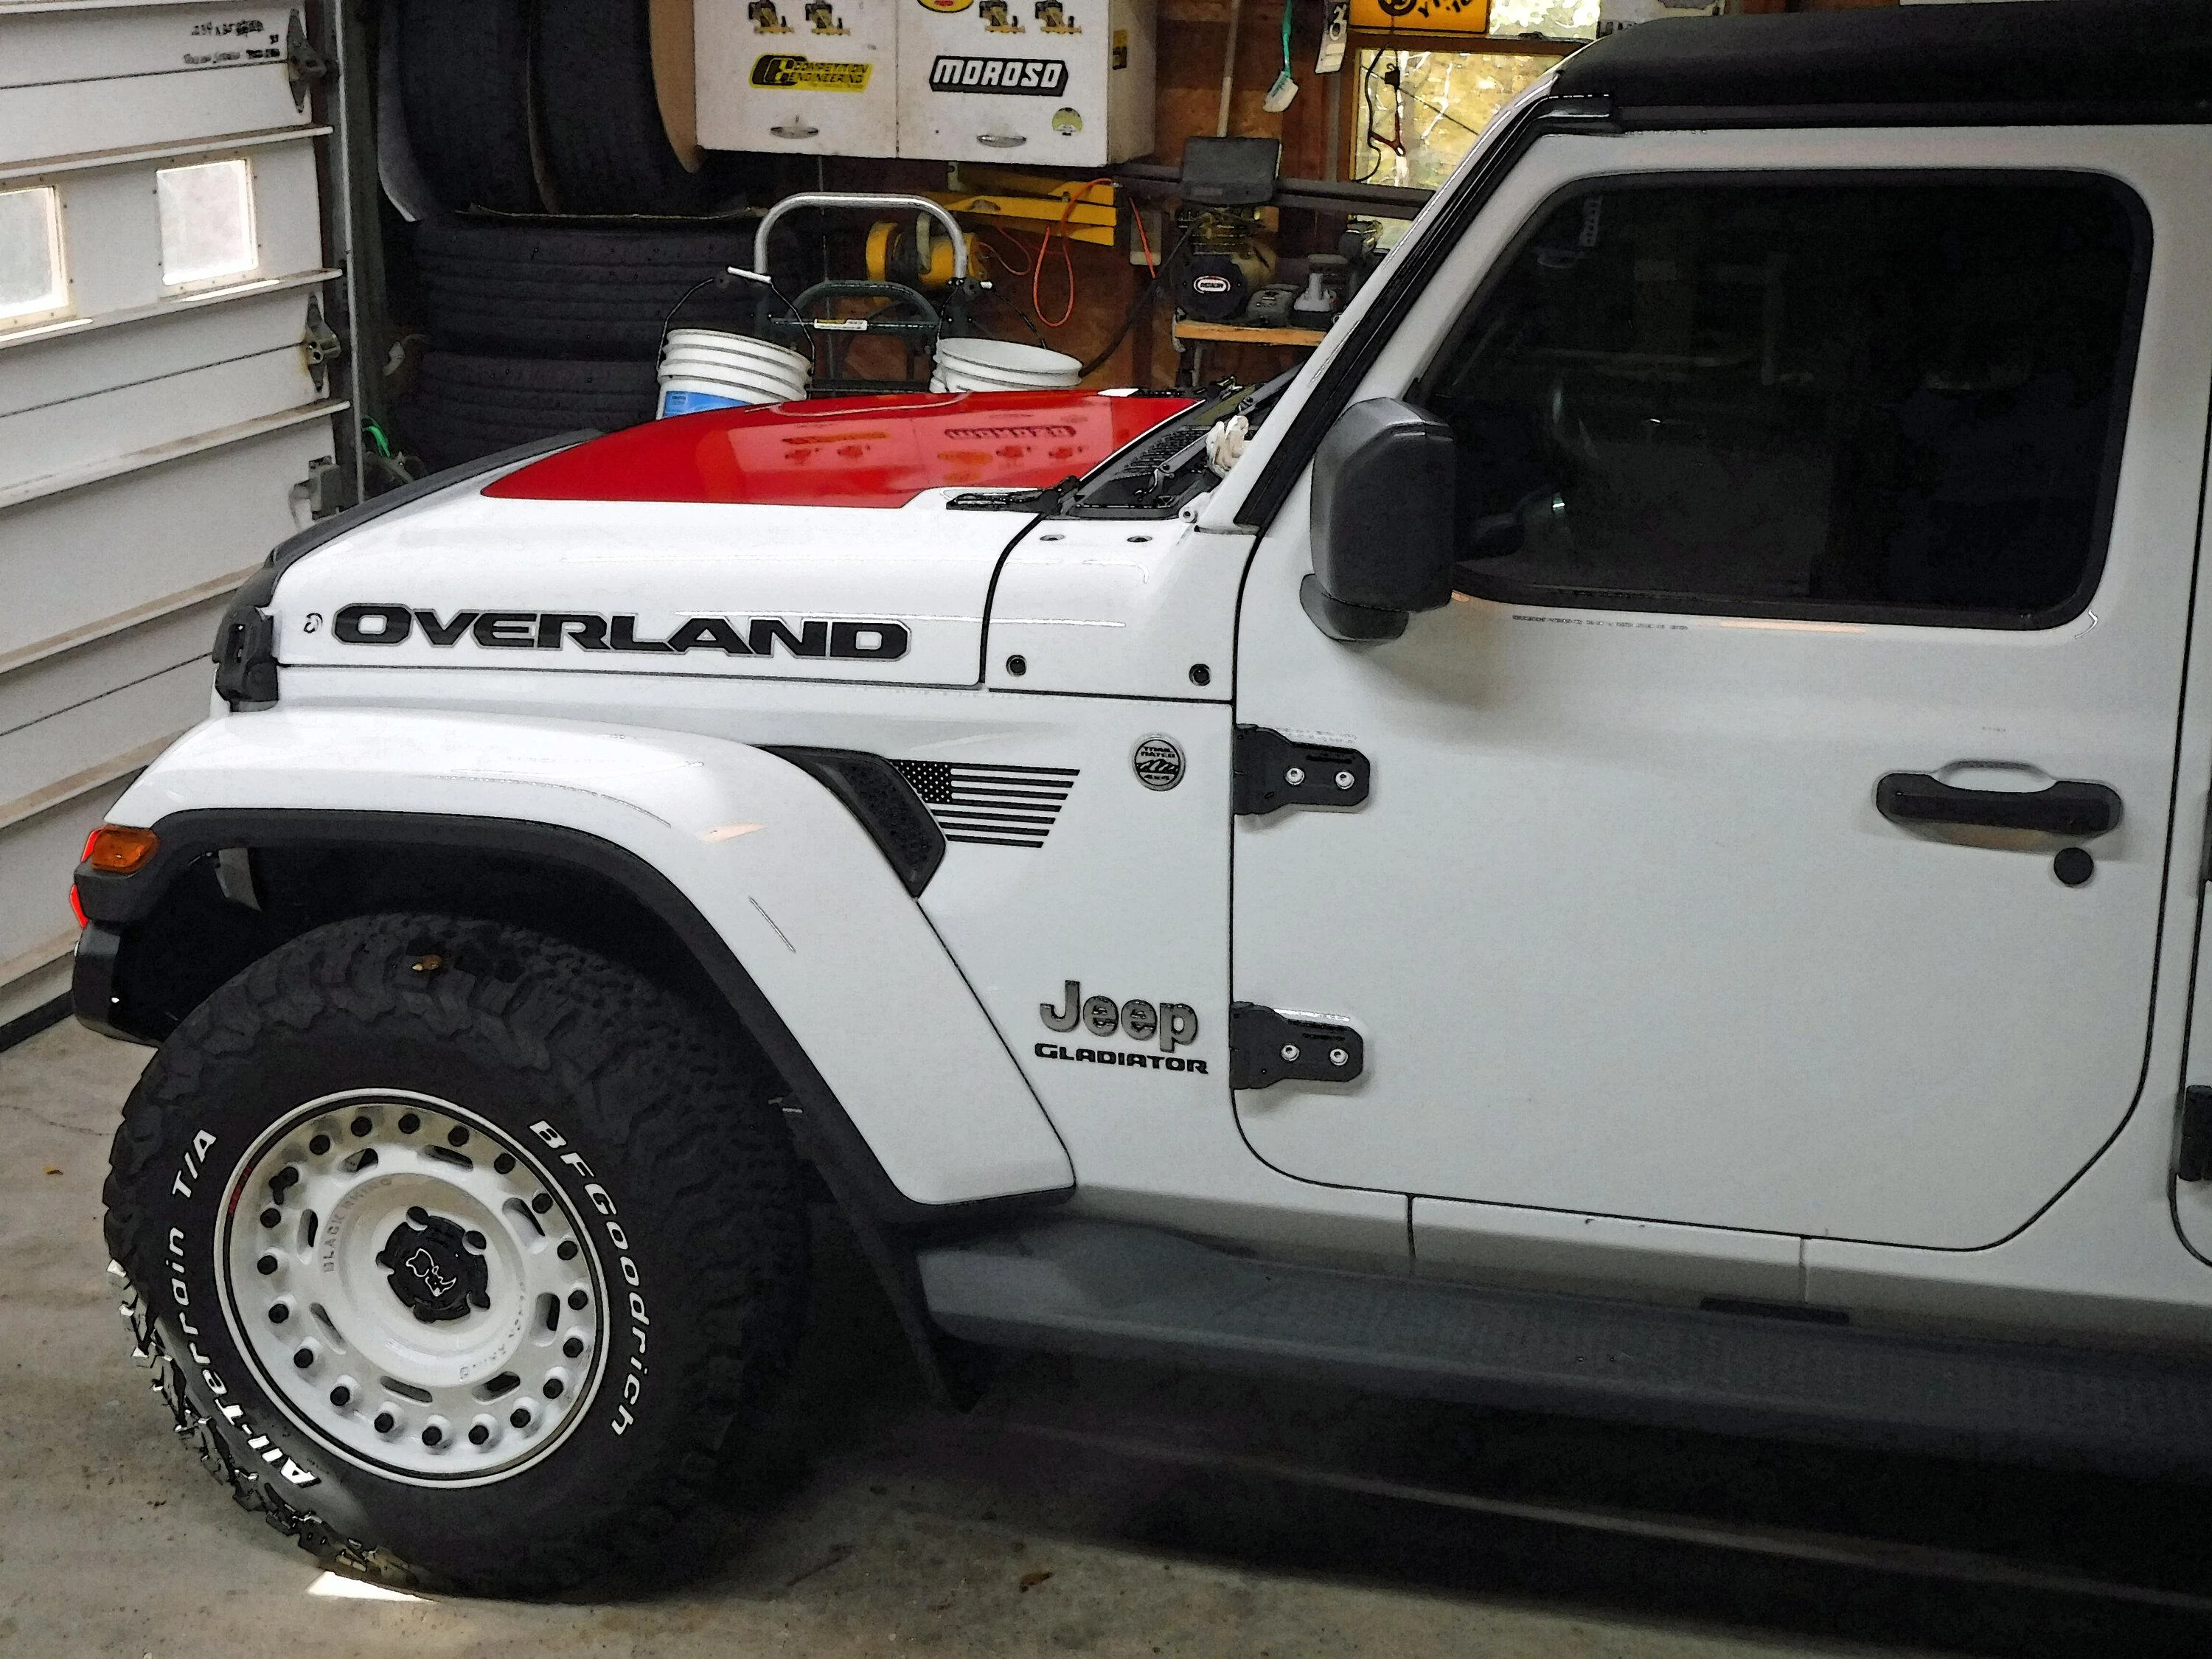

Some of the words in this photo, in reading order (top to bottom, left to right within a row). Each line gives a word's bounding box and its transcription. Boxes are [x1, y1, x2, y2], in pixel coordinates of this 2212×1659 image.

[932, 59, 1063, 88] MOROSO
[332, 602, 911, 662] OVERLAND
[1039, 980, 1198, 1053] Jeep
[1034, 1043, 1208, 1074] GLADIATOR
[172, 1129, 217, 1198] T/A
[323, 1213, 345, 1273] BLACK
[529, 1120, 650, 1436] BFGoodrich
